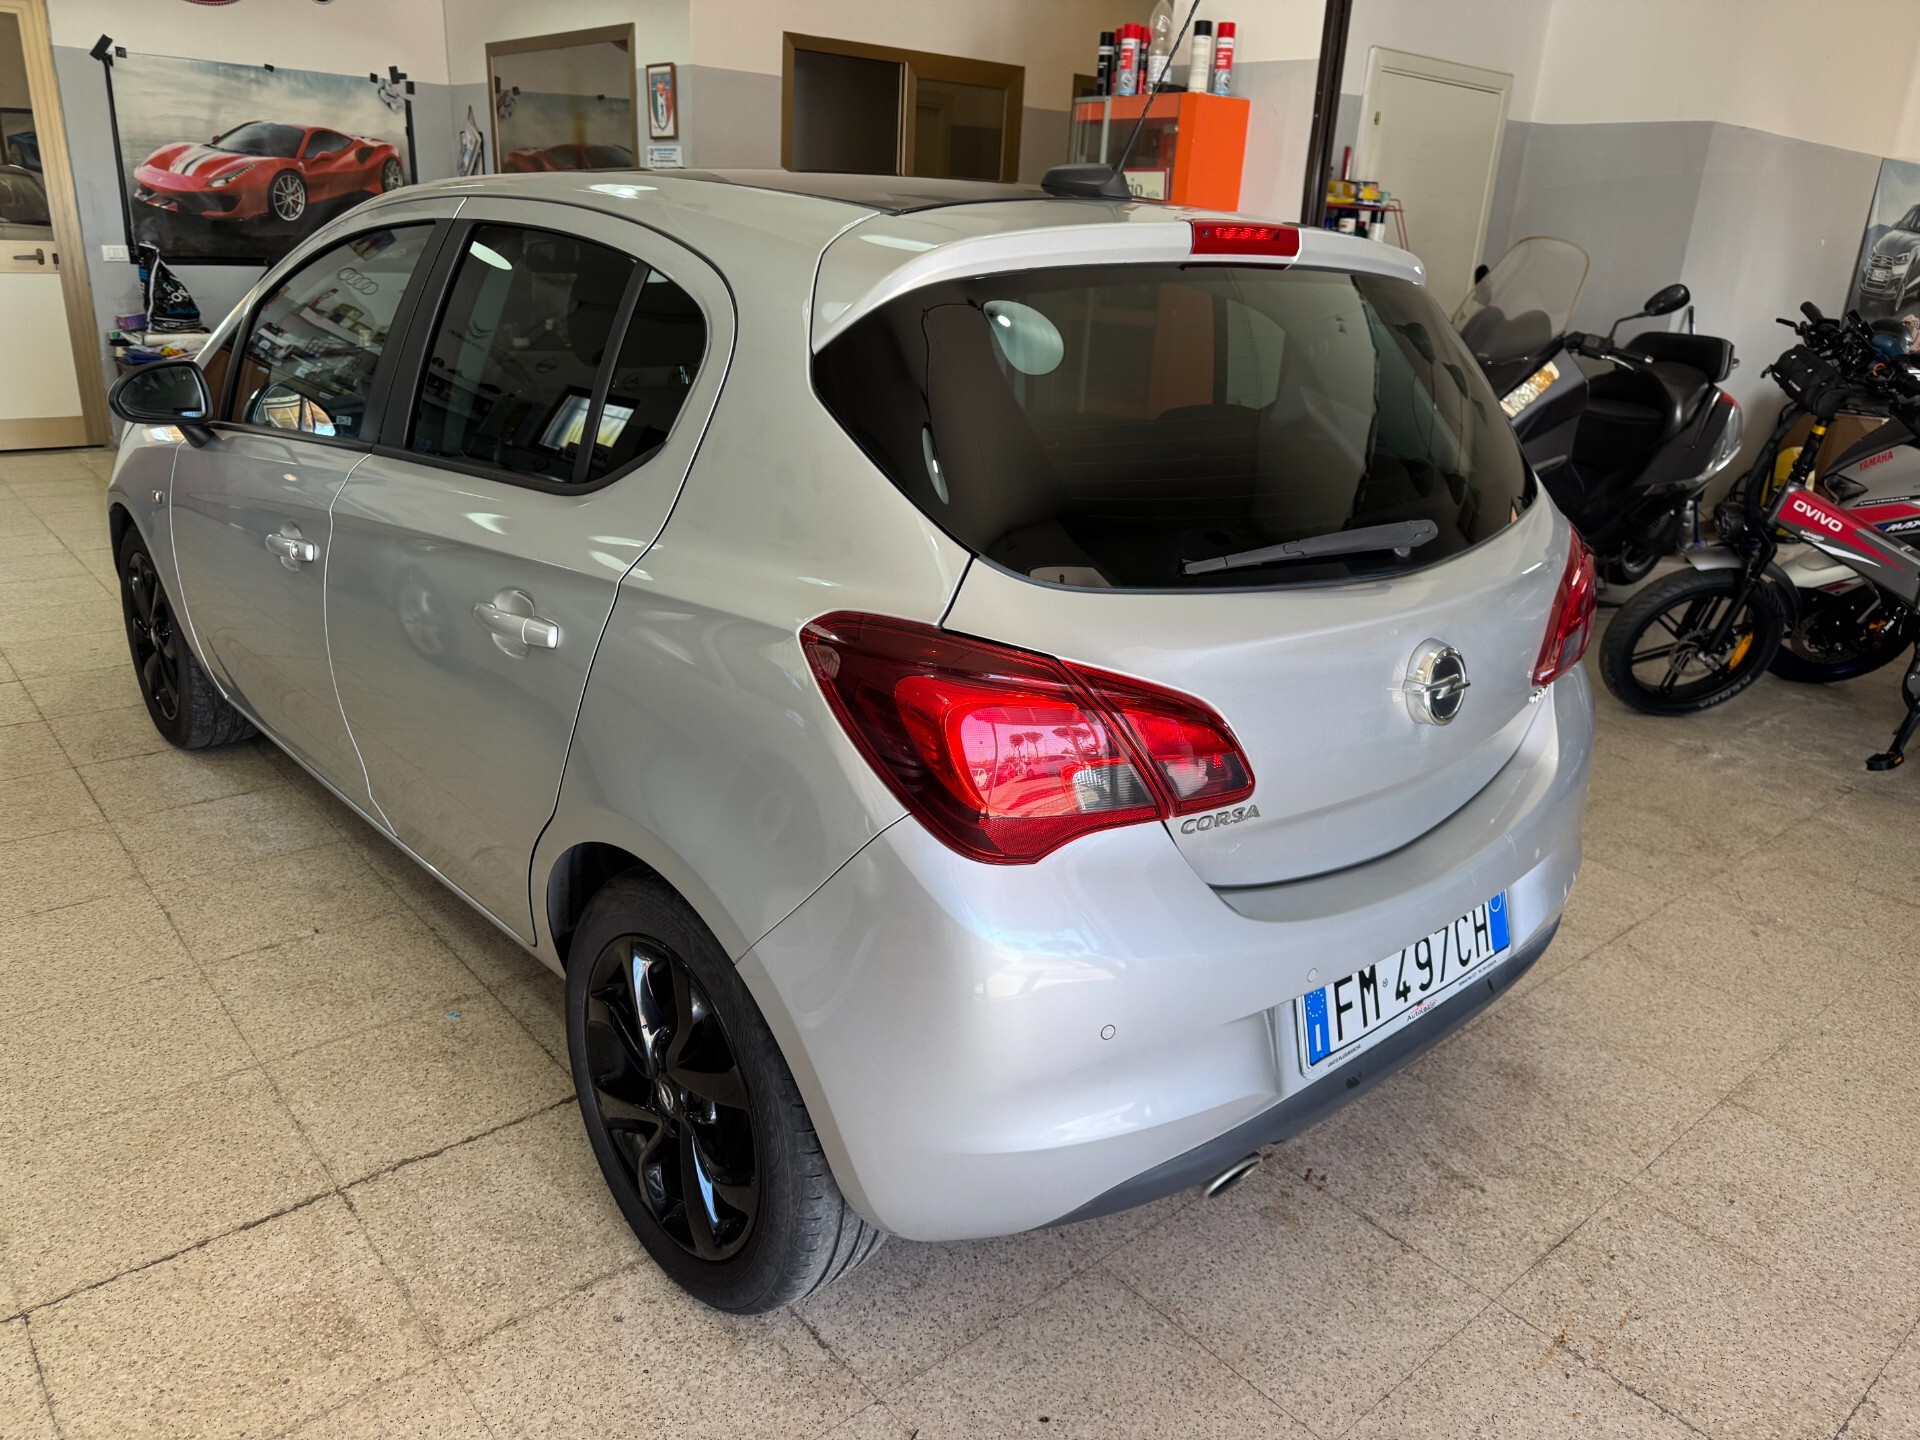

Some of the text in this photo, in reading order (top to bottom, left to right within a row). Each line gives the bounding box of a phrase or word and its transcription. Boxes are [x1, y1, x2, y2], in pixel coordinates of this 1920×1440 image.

[1859, 451, 1893, 471] YAMAHA
[1793, 500, 1843, 532] OVIVO
[1181, 804, 1260, 834] CORSA
[1333, 903, 1490, 1042] FM 497CH
